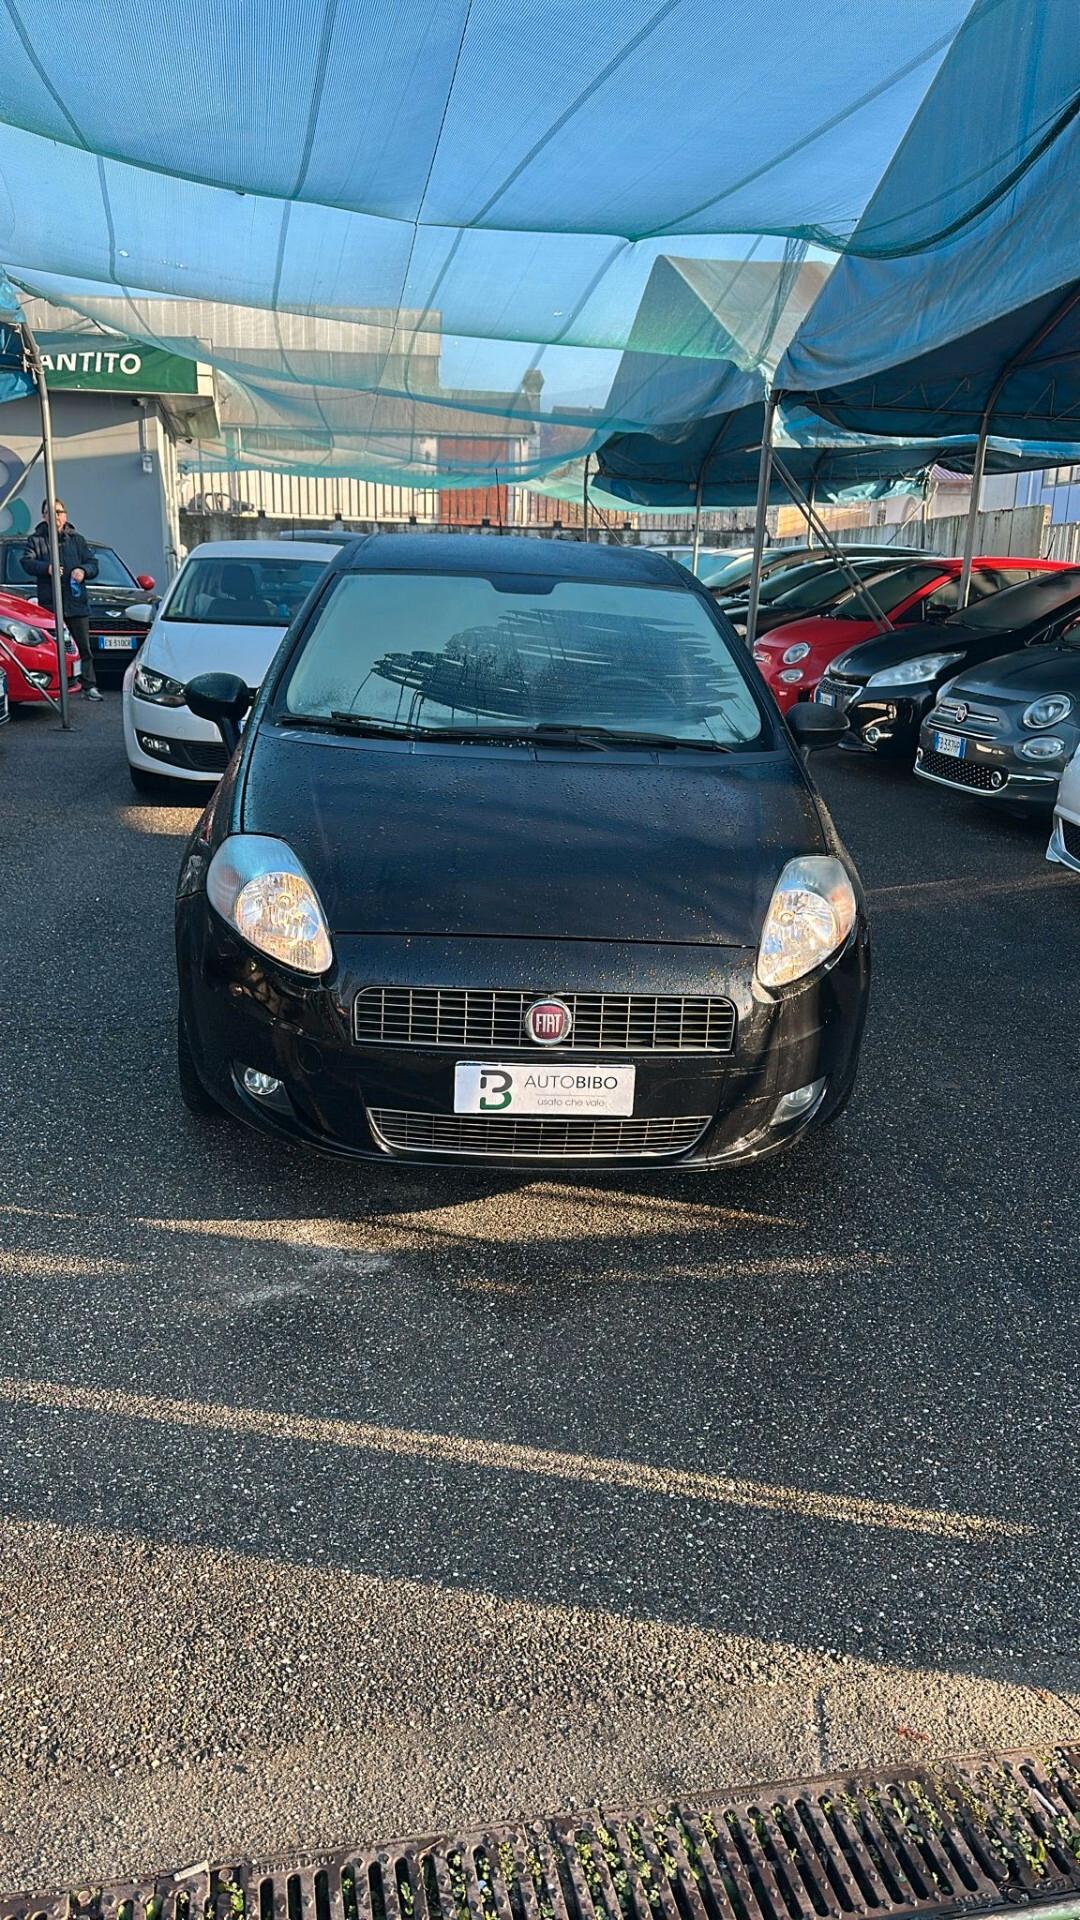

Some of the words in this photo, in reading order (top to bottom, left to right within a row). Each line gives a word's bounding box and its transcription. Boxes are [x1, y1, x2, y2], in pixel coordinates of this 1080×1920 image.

[535, 1013, 562, 1033] FIAT
[524, 1075, 618, 1090] AUTOBIBO
[537, 1097, 562, 1106] usato
[565, 1098, 583, 1106] che
[585, 1099, 606, 1107] vale
